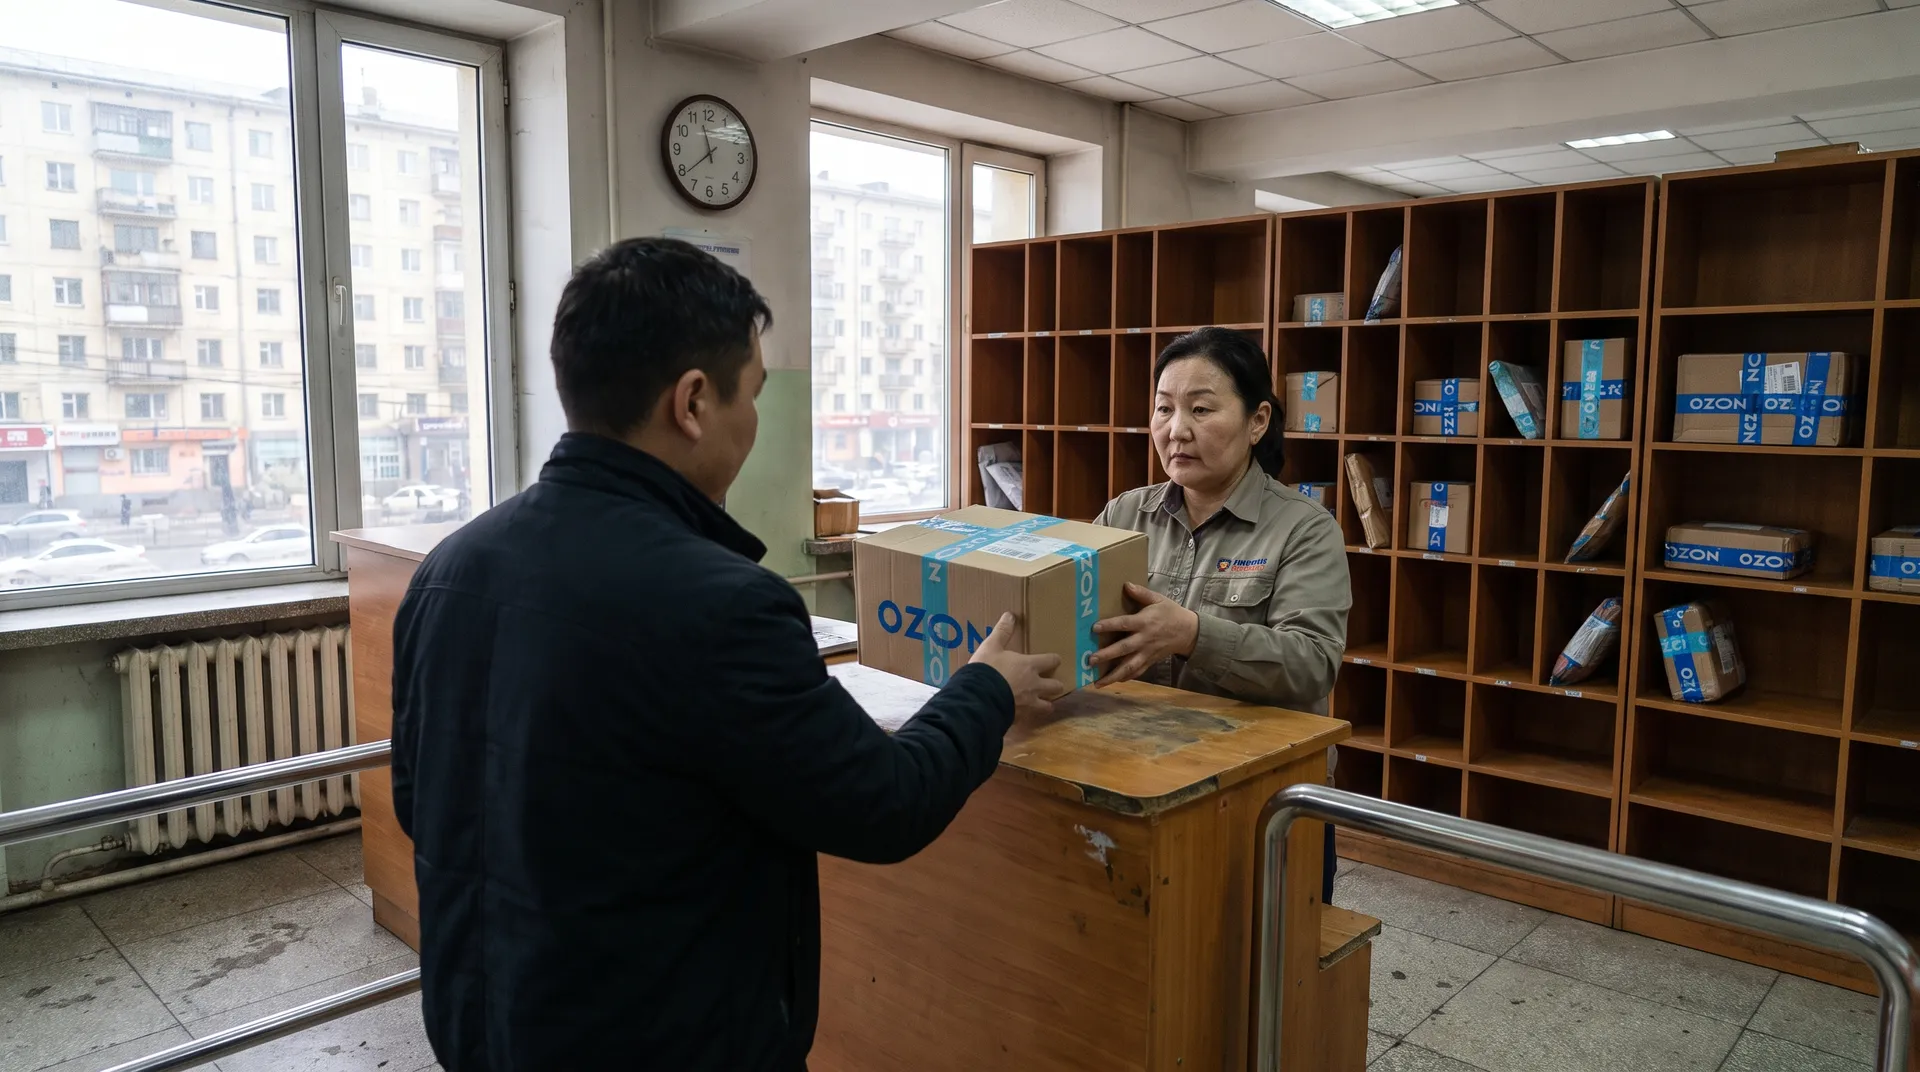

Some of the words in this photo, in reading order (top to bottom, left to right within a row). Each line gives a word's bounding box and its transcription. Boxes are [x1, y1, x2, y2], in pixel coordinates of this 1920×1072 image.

[687, 110, 697, 124] 11
[702, 109, 715, 123] 12
[676, 124, 689, 138] 10
[673, 142, 681, 156] 9
[737, 152, 745, 165] 3
[678, 163, 686, 177] 8
[690, 178, 699, 191] 7
[731, 171, 740, 184] 4
[705, 185, 714, 198] 6
[721, 182, 729, 196] 5
[1689, 396, 1747, 411] OZON
[1739, 552, 1796, 568] OZON
[1900, 561, 1920, 575] O
[877, 599, 993, 655] OZON
